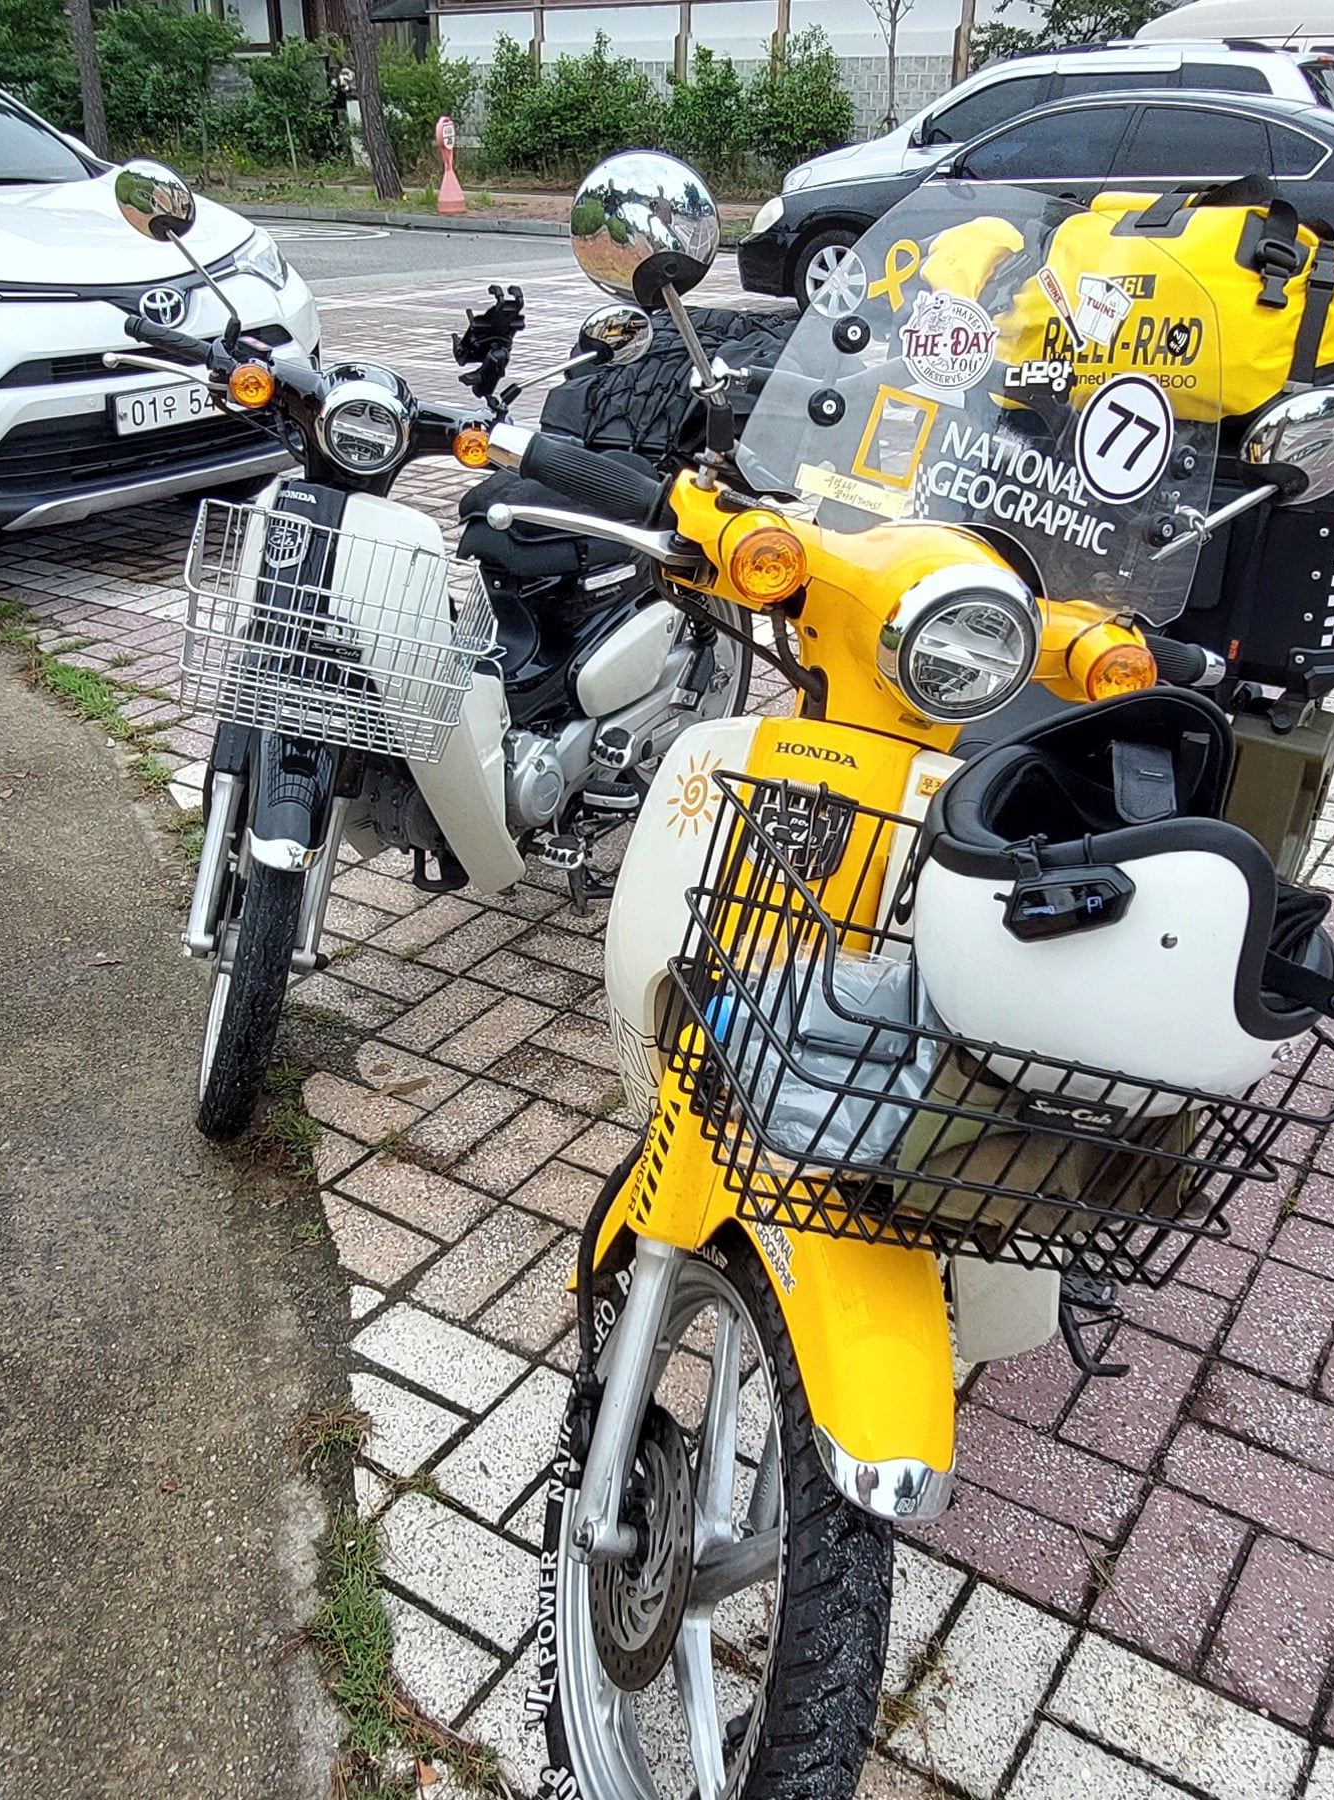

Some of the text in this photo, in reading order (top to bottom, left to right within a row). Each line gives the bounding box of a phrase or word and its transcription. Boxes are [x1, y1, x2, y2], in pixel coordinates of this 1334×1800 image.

[1044, 274, 1062, 303] TWINS
[1087, 295, 1116, 319] TWINS
[903, 327, 997, 359] THE DAY
[923, 366, 964, 384] DESERVE
[951, 355, 978, 373] YOU
[1004, 360, 1073, 392] 다모앙
[131, 395, 176, 427] 01우
[1096, 400, 1161, 472] 77
[940, 421, 1089, 507] NATIONAL
[928, 460, 1116, 556] GEOGRAPHIC
[775, 741, 859, 770] HONDA
[628, 1126, 657, 1213] DANGER
[537, 1549, 558, 1667] POWER
